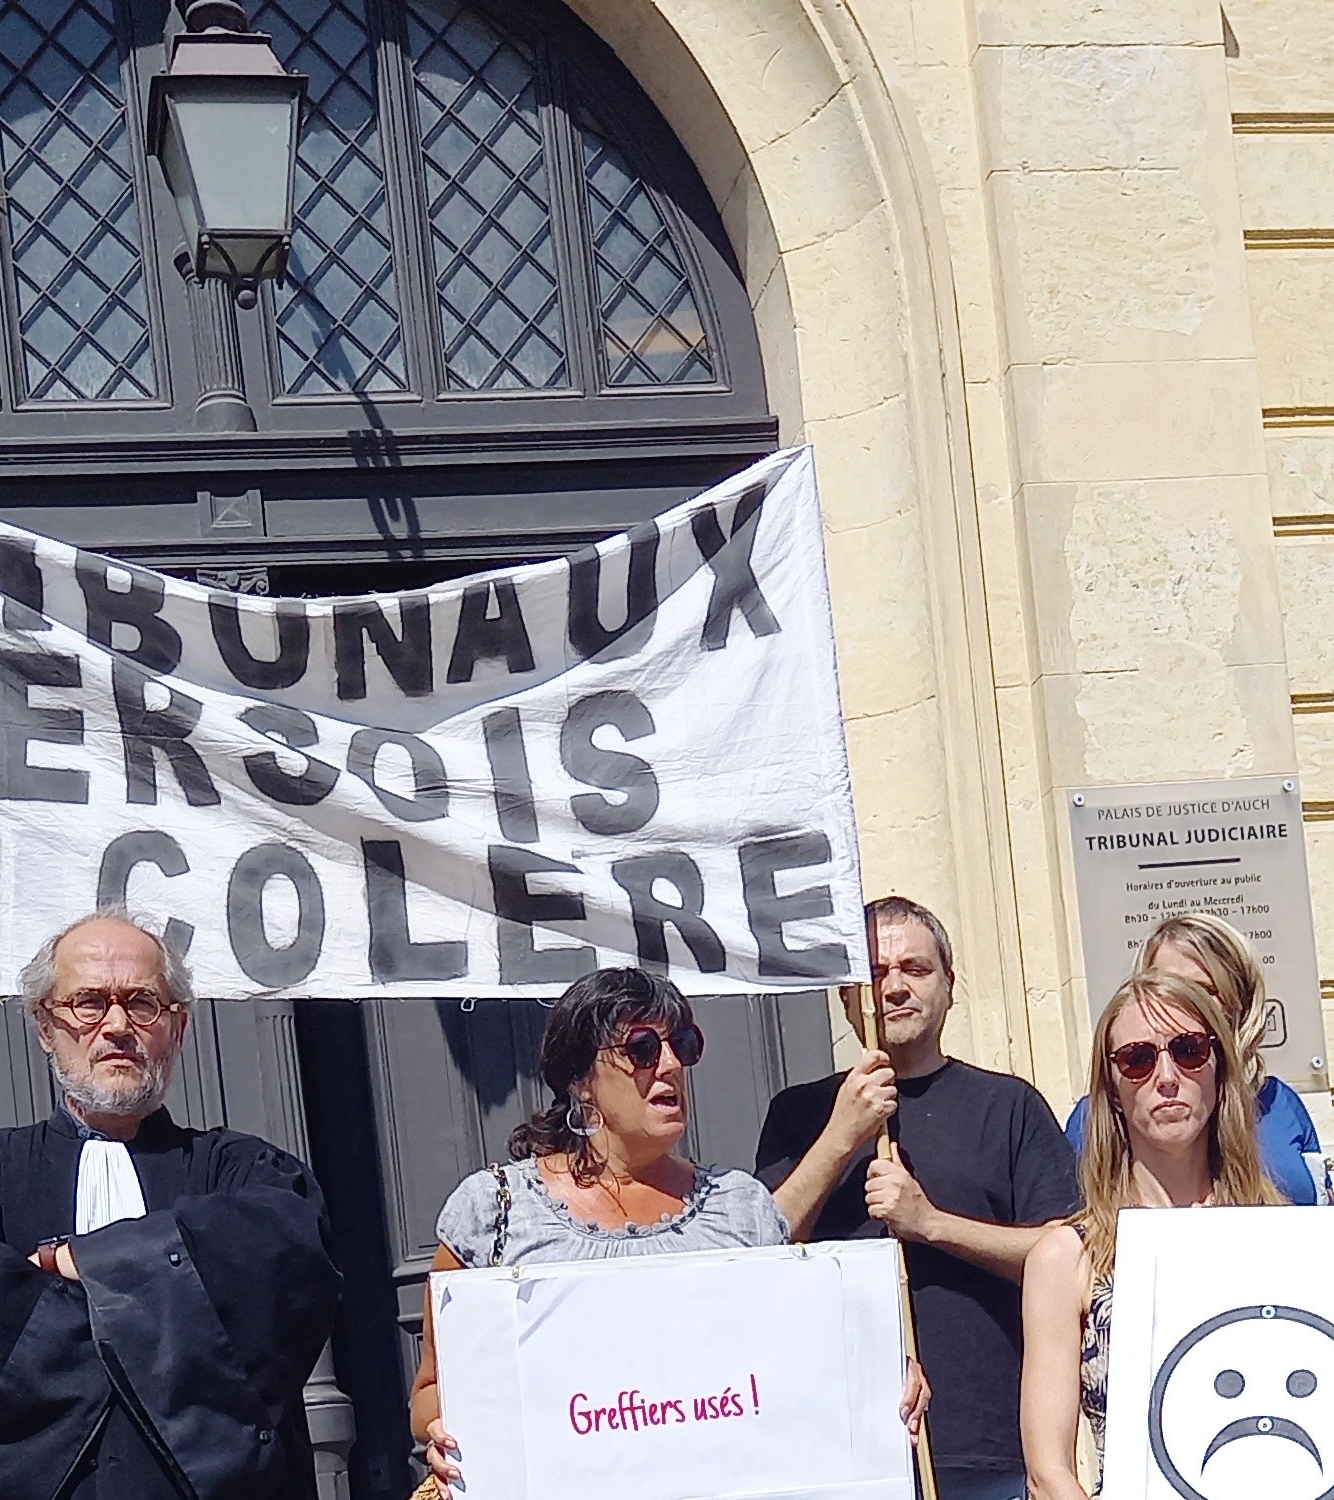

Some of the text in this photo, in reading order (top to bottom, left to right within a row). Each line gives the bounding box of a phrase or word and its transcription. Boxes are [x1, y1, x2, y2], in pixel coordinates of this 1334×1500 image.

[1097, 798, 1271, 821] PALAIS DE JUSTICE D'AUCH
[1085, 823, 1288, 851] TRIBUNAL JUDICIAIRE
[1126, 873, 1262, 892] Horaires d'ouverture au public
[95, 829, 852, 988] COLERE
[1147, 894, 1244, 910] du Lundi au Mercredi
[1240, 904, 1270, 916] 17h00
[1244, 929, 1272, 940] 7h00
[568, 1388, 687, 1438] Greffiers
[692, 1385, 744, 1422] usés
